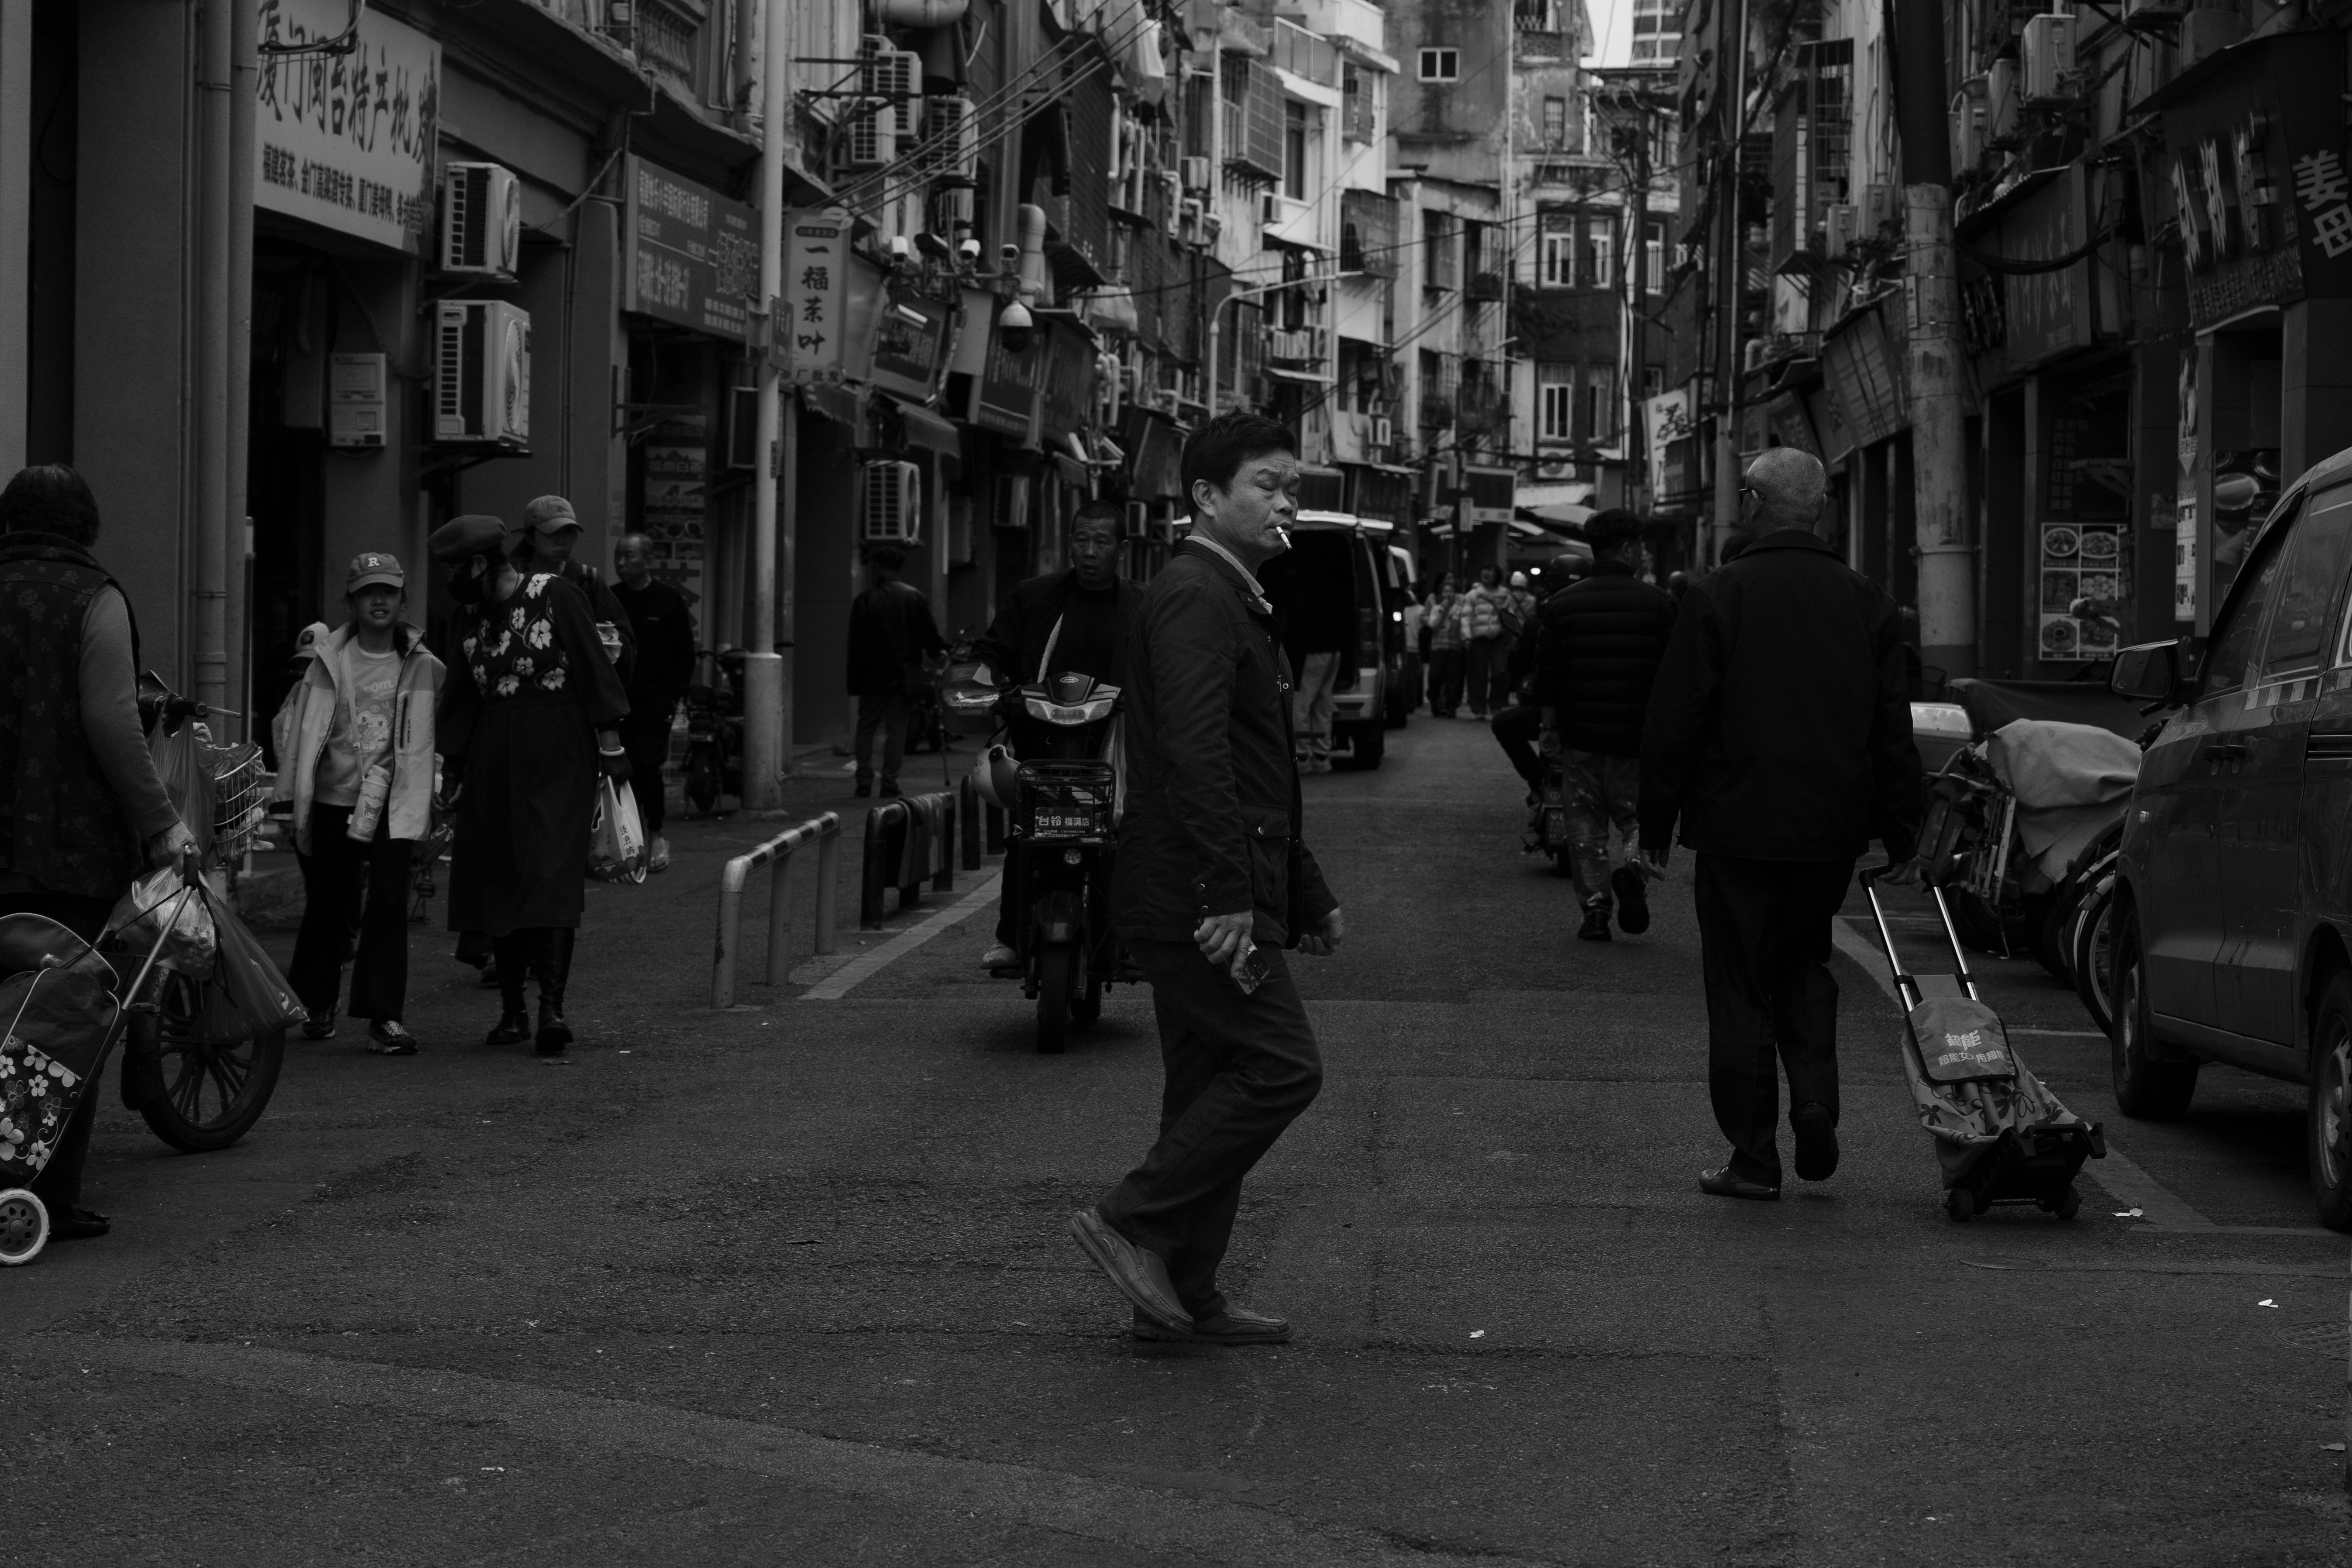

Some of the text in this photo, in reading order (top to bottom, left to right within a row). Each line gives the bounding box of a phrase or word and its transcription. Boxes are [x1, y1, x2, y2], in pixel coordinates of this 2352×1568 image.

[797, 244, 830, 356] 一福茶叶
[367, 556, 380, 567] R
[1036, 816, 1090, 826] 台铃 福满店
[1945, 1029, 1982, 1051] 超能
